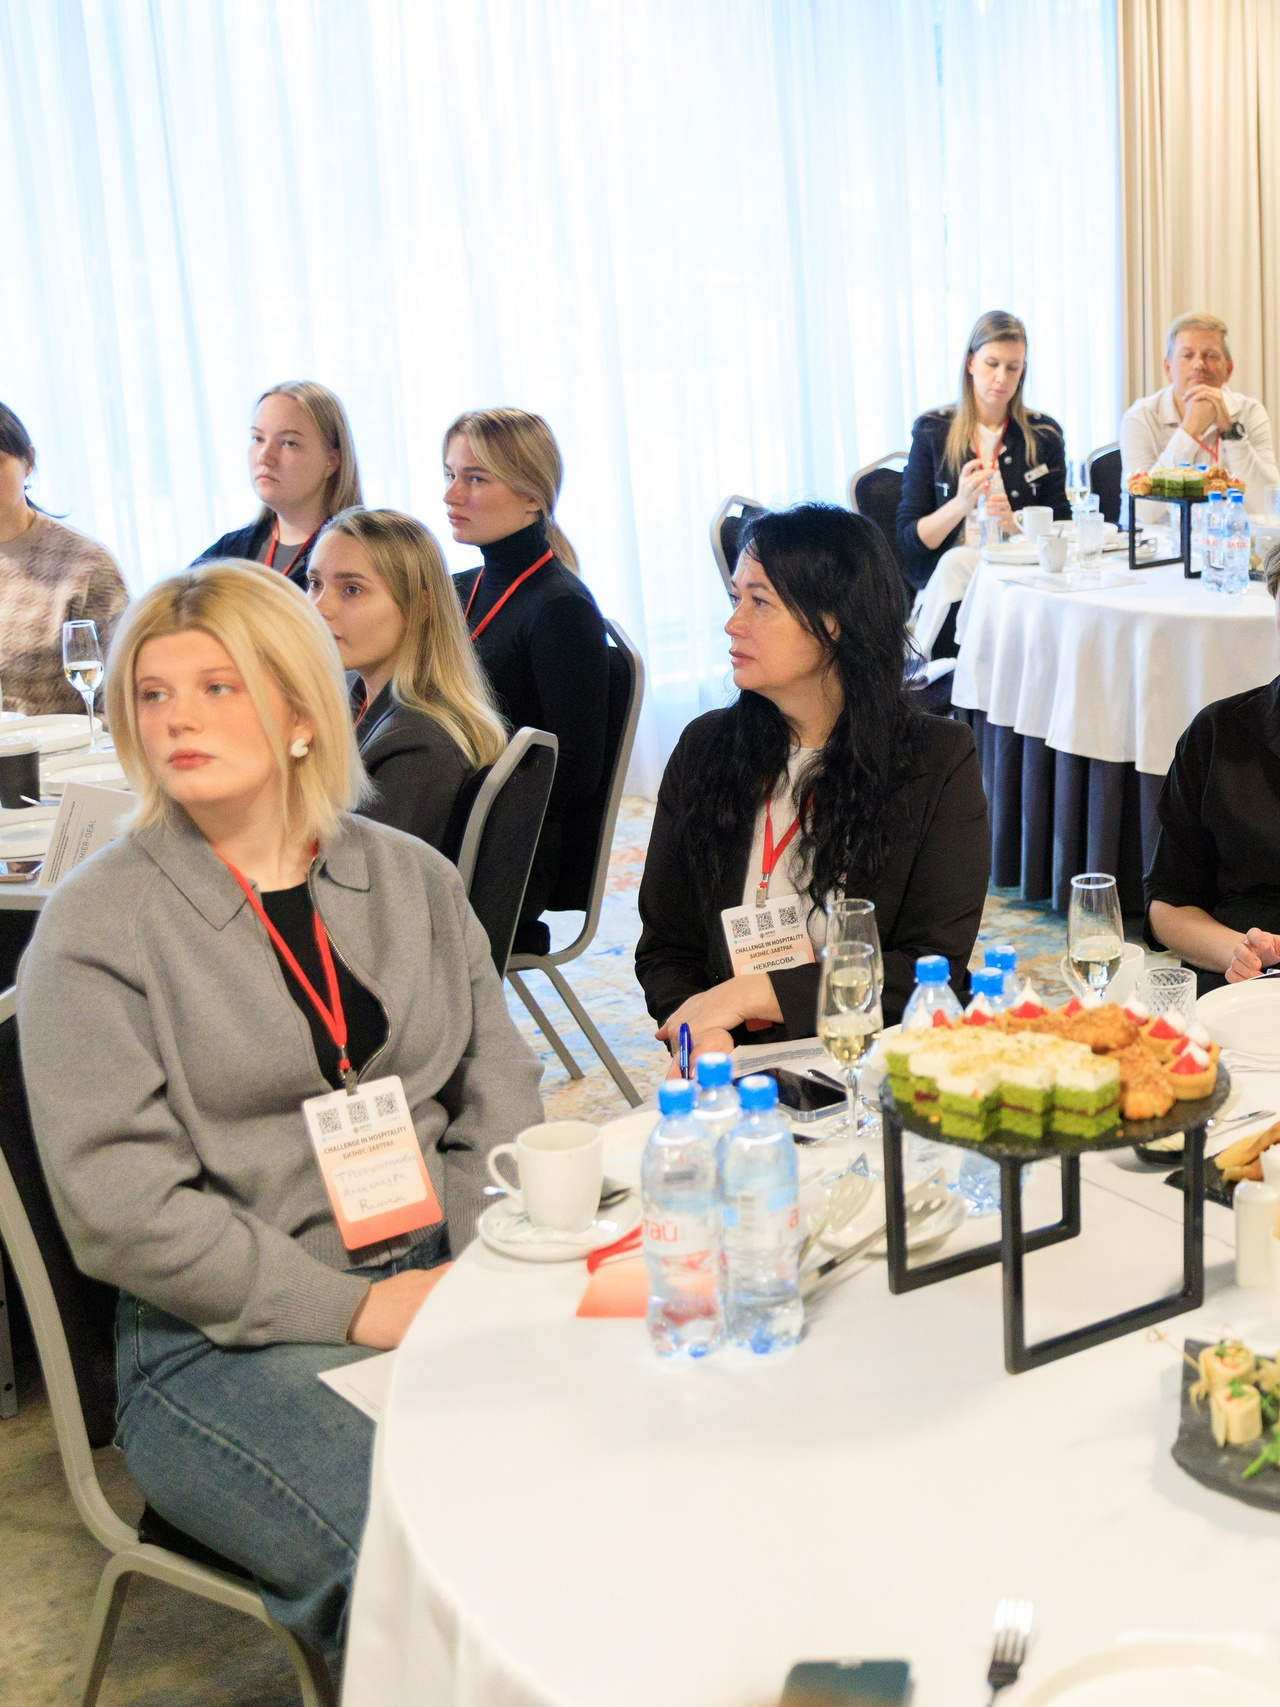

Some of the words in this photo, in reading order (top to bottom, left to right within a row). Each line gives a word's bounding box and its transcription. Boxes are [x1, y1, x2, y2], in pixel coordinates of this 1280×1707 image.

[735, 942, 765, 955] CHALLENGE
[771, 933, 804, 946] HOSPITALITY
[749, 944, 793, 959] БИЗНЕС-ЗАВТРАК
[753, 956, 795, 971] НЕКРАСОВА
[323, 1139, 360, 1154] CHALLENGE
[360, 1136, 368, 1144] IN
[368, 1126, 407, 1142] HOSPITALITY
[342, 1140, 395, 1160] БИЗНЕС-ЗАВТРАК
